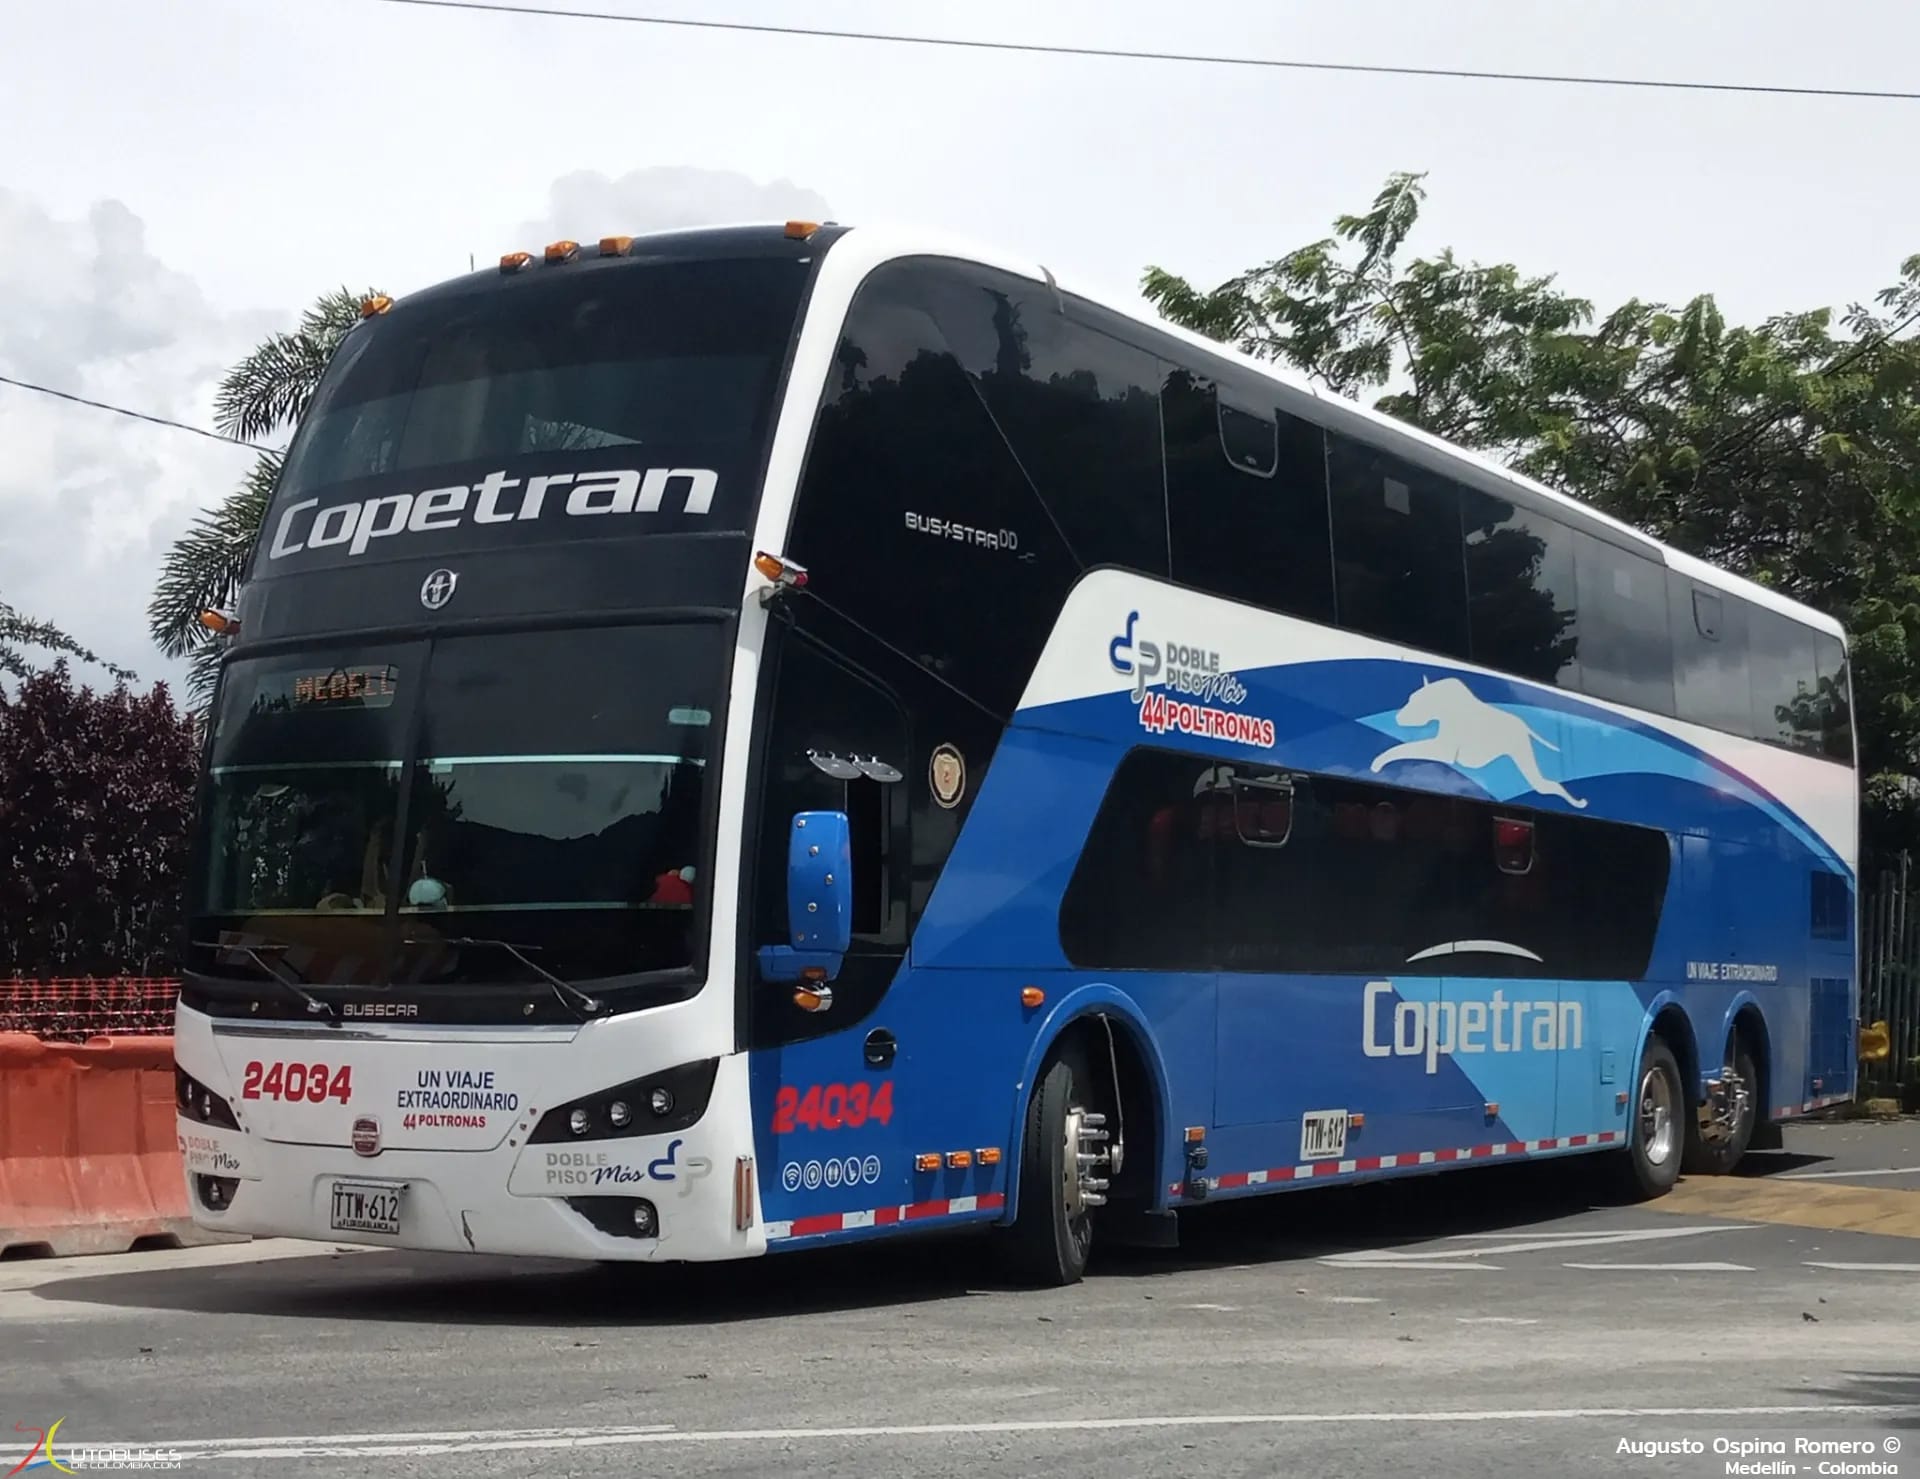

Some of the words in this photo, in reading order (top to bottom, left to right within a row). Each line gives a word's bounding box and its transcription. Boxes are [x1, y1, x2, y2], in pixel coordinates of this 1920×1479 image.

[269, 467, 719, 560] Copetran
[1166, 642, 1220, 673] DOBLE
[1166, 667, 1204, 695] PISO
[1141, 692, 1166, 735] 44
[1166, 701, 1275, 748] POLTRONAS
[343, 1004, 418, 1017] BUSSCAR
[1362, 981, 1583, 1075] Copetran
[242, 1061, 352, 1105] 24034
[418, 1070, 441, 1088] UN
[446, 1071, 495, 1089] VIAJE
[397, 1090, 519, 1112] EXTRAORDINARIO
[772, 1080, 895, 1135] 24034
[403, 1114, 417, 1130] 44
[419, 1114, 486, 1129] POLTRONAS
[546, 1152, 609, 1167] DOBLE
[546, 1169, 588, 1185] PISO
[590, 1164, 645, 1186] Más
